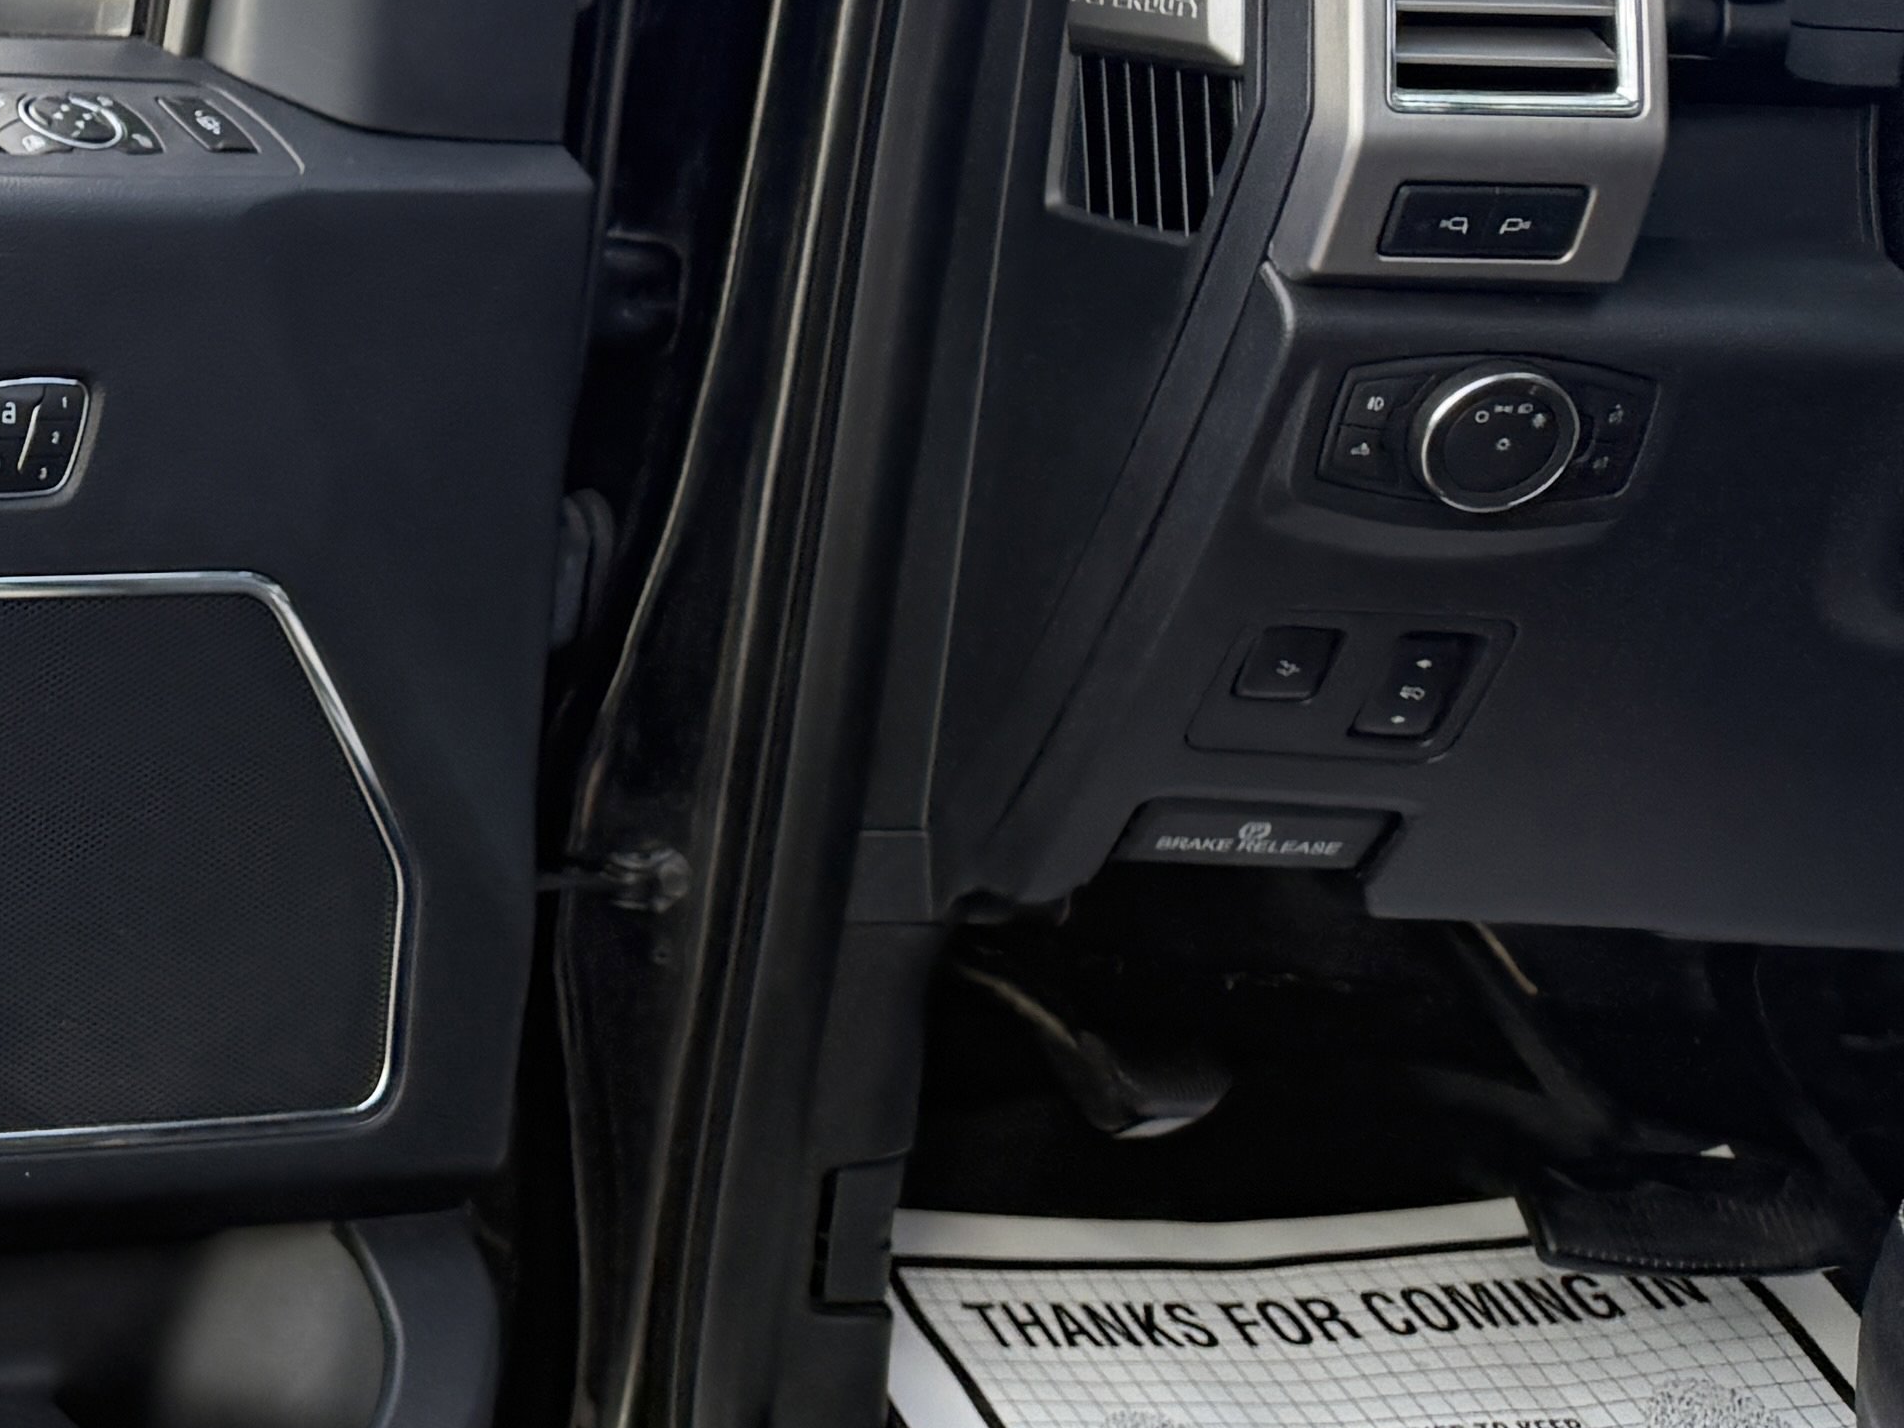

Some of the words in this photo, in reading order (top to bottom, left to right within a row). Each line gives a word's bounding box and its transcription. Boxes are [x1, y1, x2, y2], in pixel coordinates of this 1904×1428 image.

[51, 430, 60, 445] 2
[39, 466, 48, 481] 3
[1155, 836, 1234, 852] BRAKE
[1235, 838, 1344, 856] RELEASE
[960, 1300, 1220, 1348] THANKS
[1216, 1296, 1363, 1348] FOR
[1360, 1274, 1627, 1336] COMING
[1625, 1274, 1711, 1311] IN
